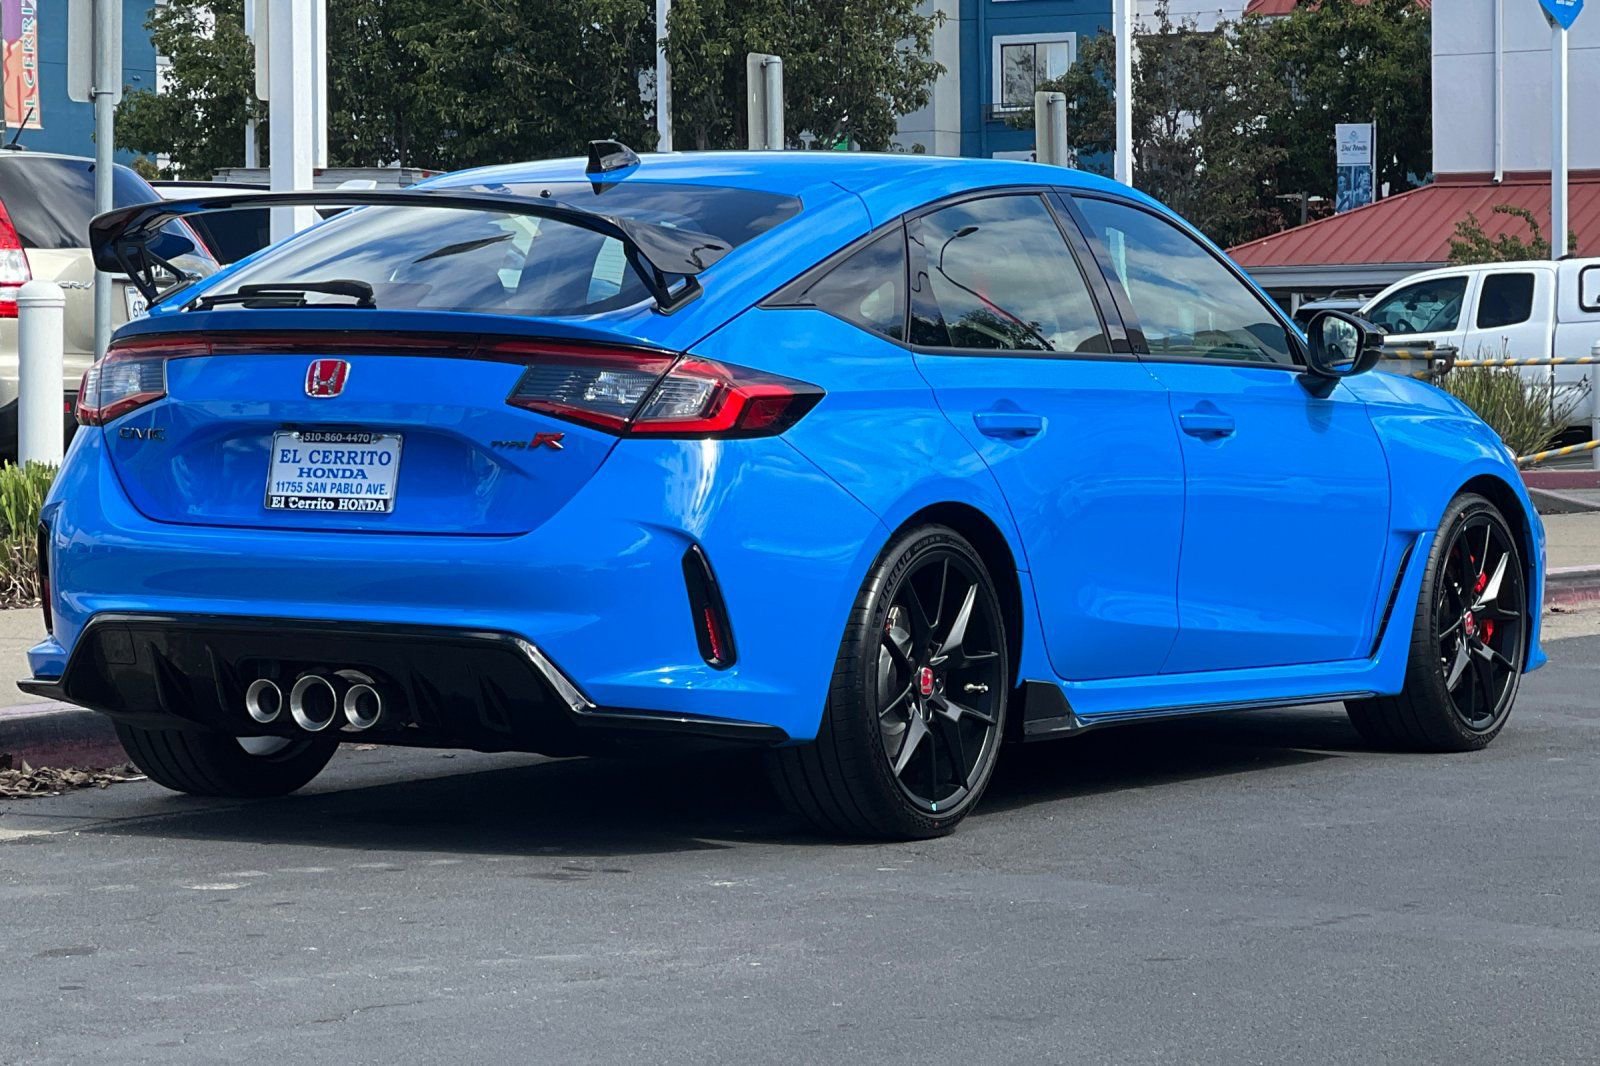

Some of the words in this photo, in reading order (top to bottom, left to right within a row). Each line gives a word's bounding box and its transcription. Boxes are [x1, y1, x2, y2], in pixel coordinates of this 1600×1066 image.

[22, 0, 36, 88] CERRI
[24, 96, 37, 122] EL
[119, 427, 165, 440] CIVIC
[304, 432, 370, 443] 510-860-4470
[528, 431, 565, 450] R
[279, 449, 302, 464] EL
[308, 449, 392, 466] CERRITO
[297, 467, 369, 480] HONDA
[275, 481, 303, 493] 11755
[305, 481, 327, 494] SAN
[330, 482, 363, 495] PABLO
[271, 496, 285, 508] El
[288, 496, 335, 510] Cerrito
[338, 498, 386, 512] HONDA
